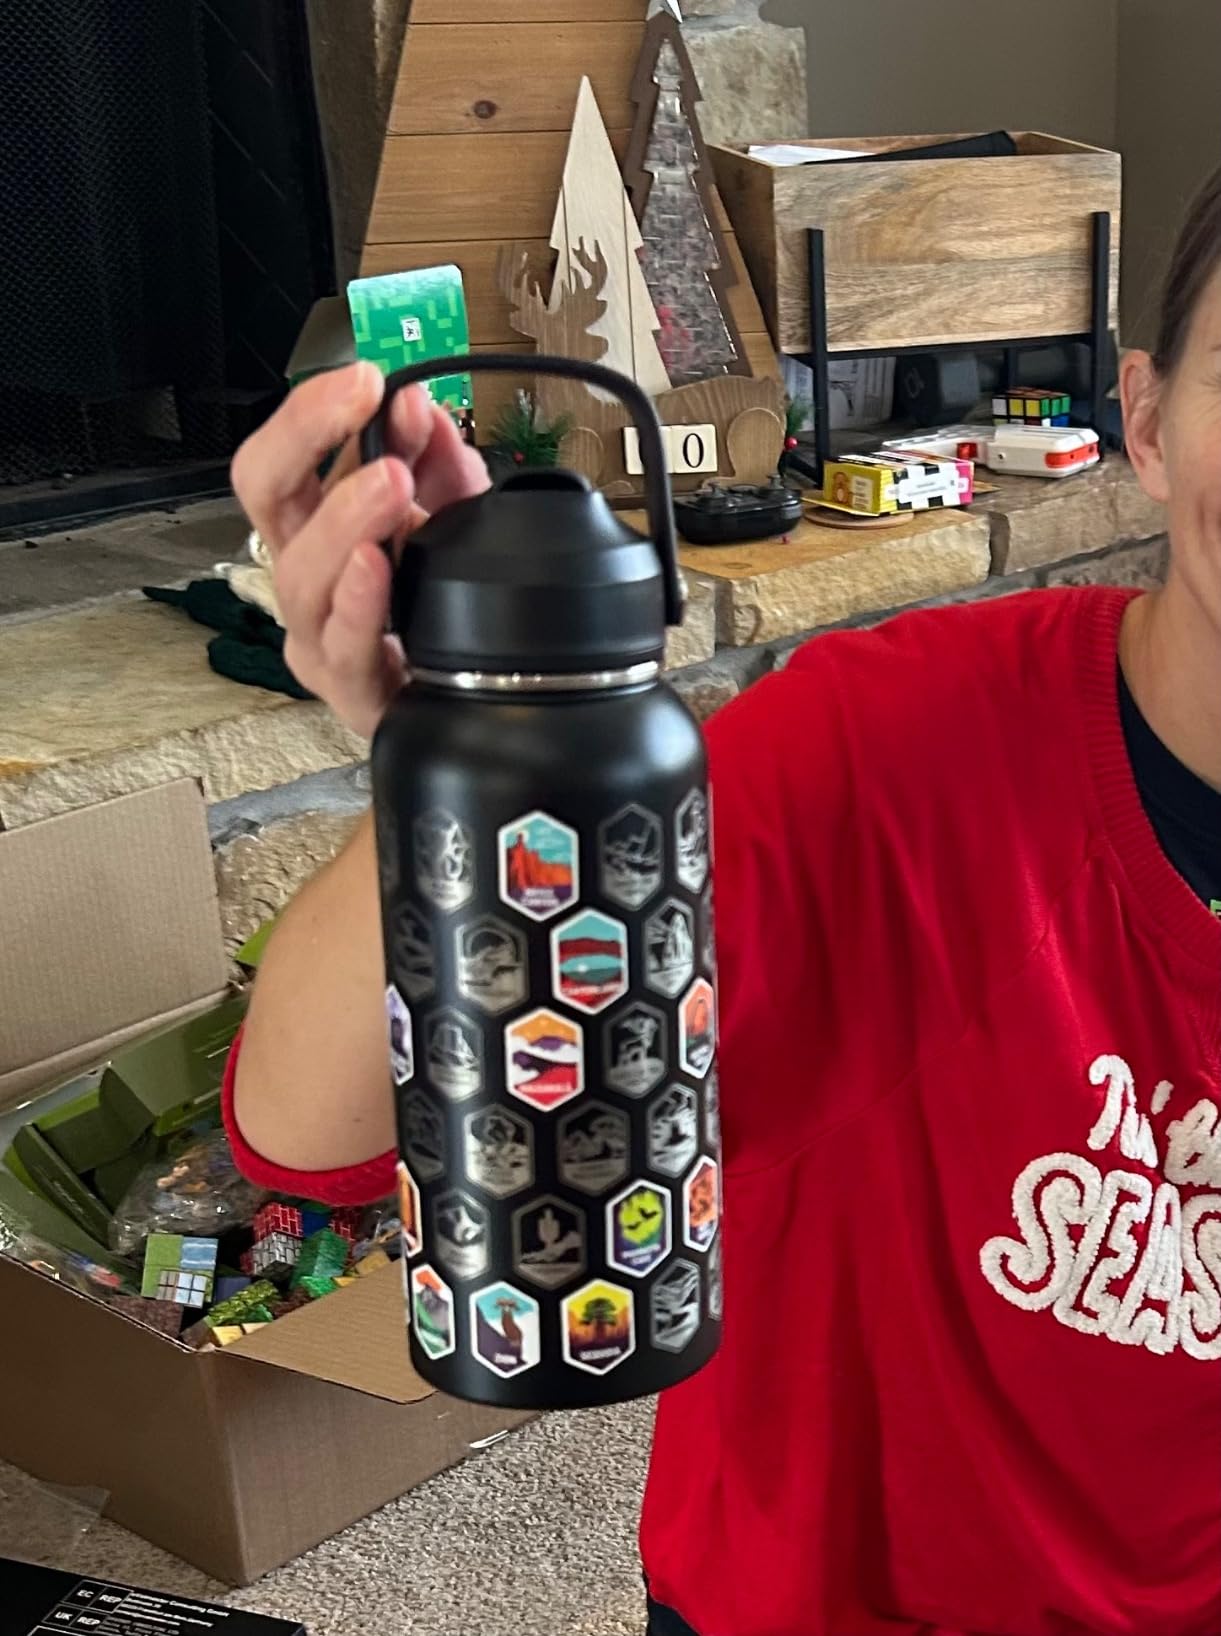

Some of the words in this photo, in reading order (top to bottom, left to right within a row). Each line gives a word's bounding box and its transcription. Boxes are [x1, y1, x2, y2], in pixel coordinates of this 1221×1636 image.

[683, 433, 704, 468] 0
[77, 1589, 94, 1598] EC
[99, 1594, 122, 1603] REP
[54, 1611, 73, 1621] UK
[77, 1616, 101, 1625] REP
